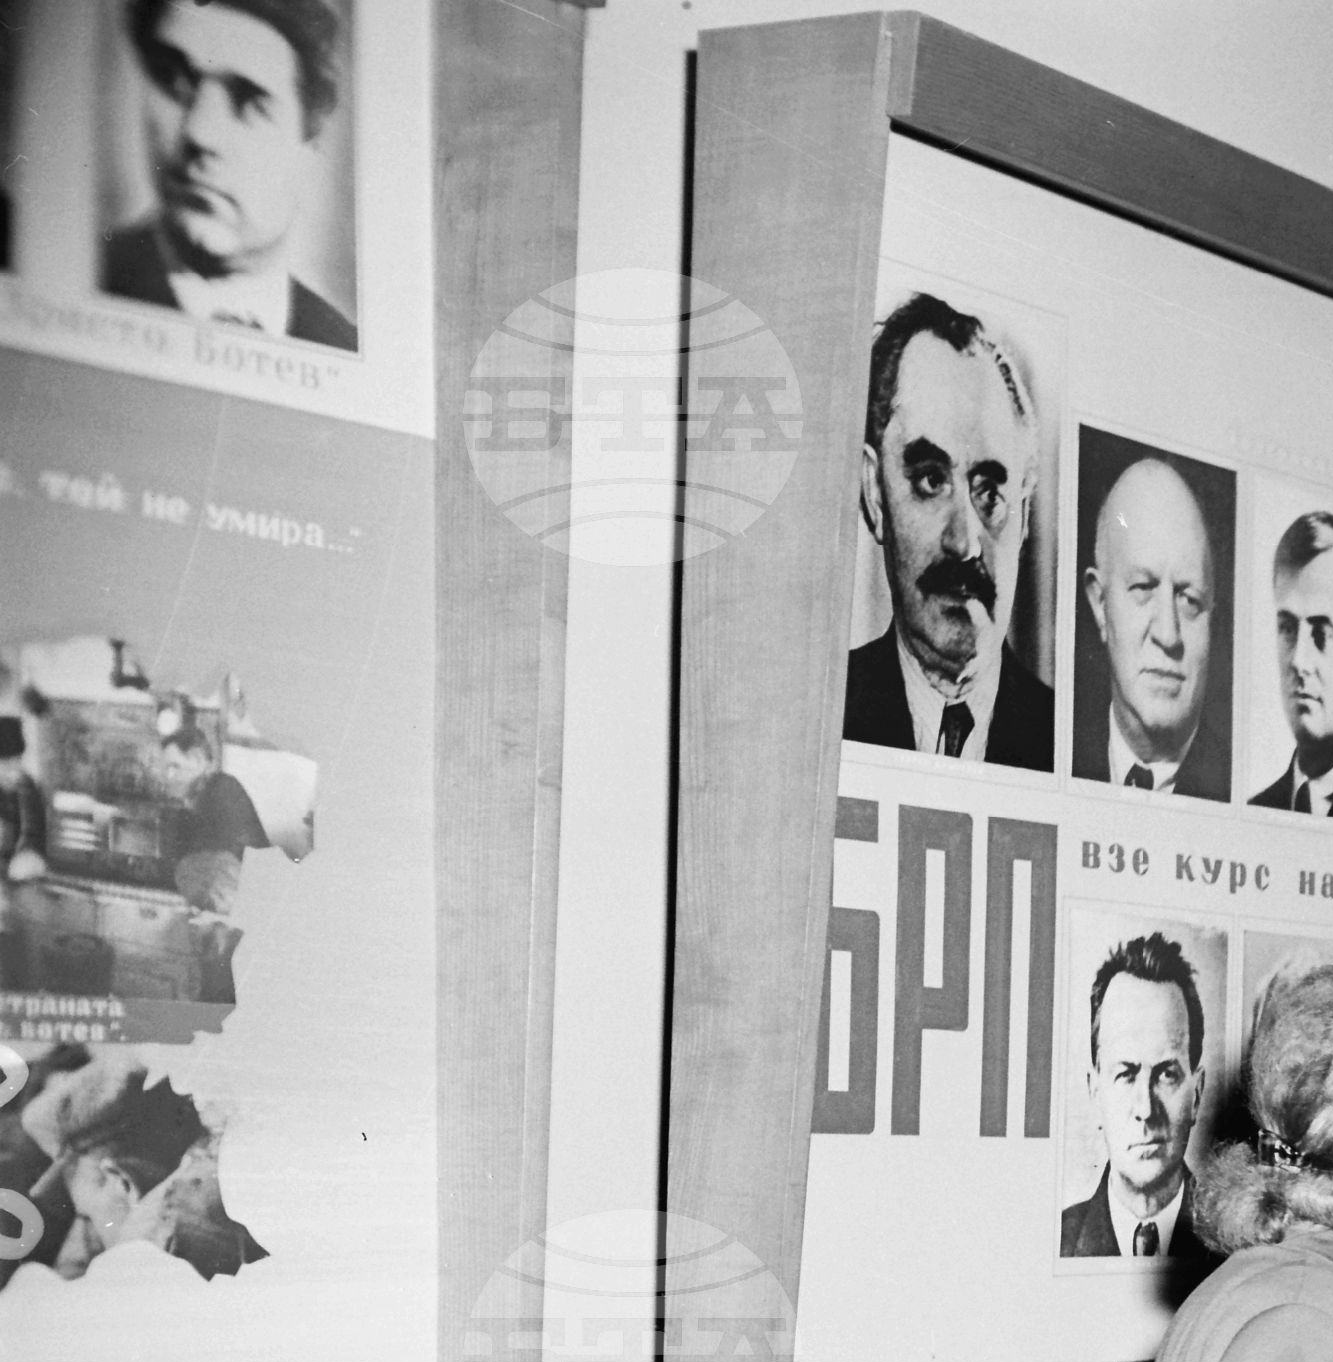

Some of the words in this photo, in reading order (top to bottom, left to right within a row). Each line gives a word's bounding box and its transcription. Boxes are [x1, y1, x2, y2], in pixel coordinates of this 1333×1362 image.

[38, 469, 128, 514] той
[142, 488, 191, 526] не
[812, 797, 1058, 1138] БРП
[1081, 839, 1149, 876] взе
[1175, 852, 1270, 896] курс
